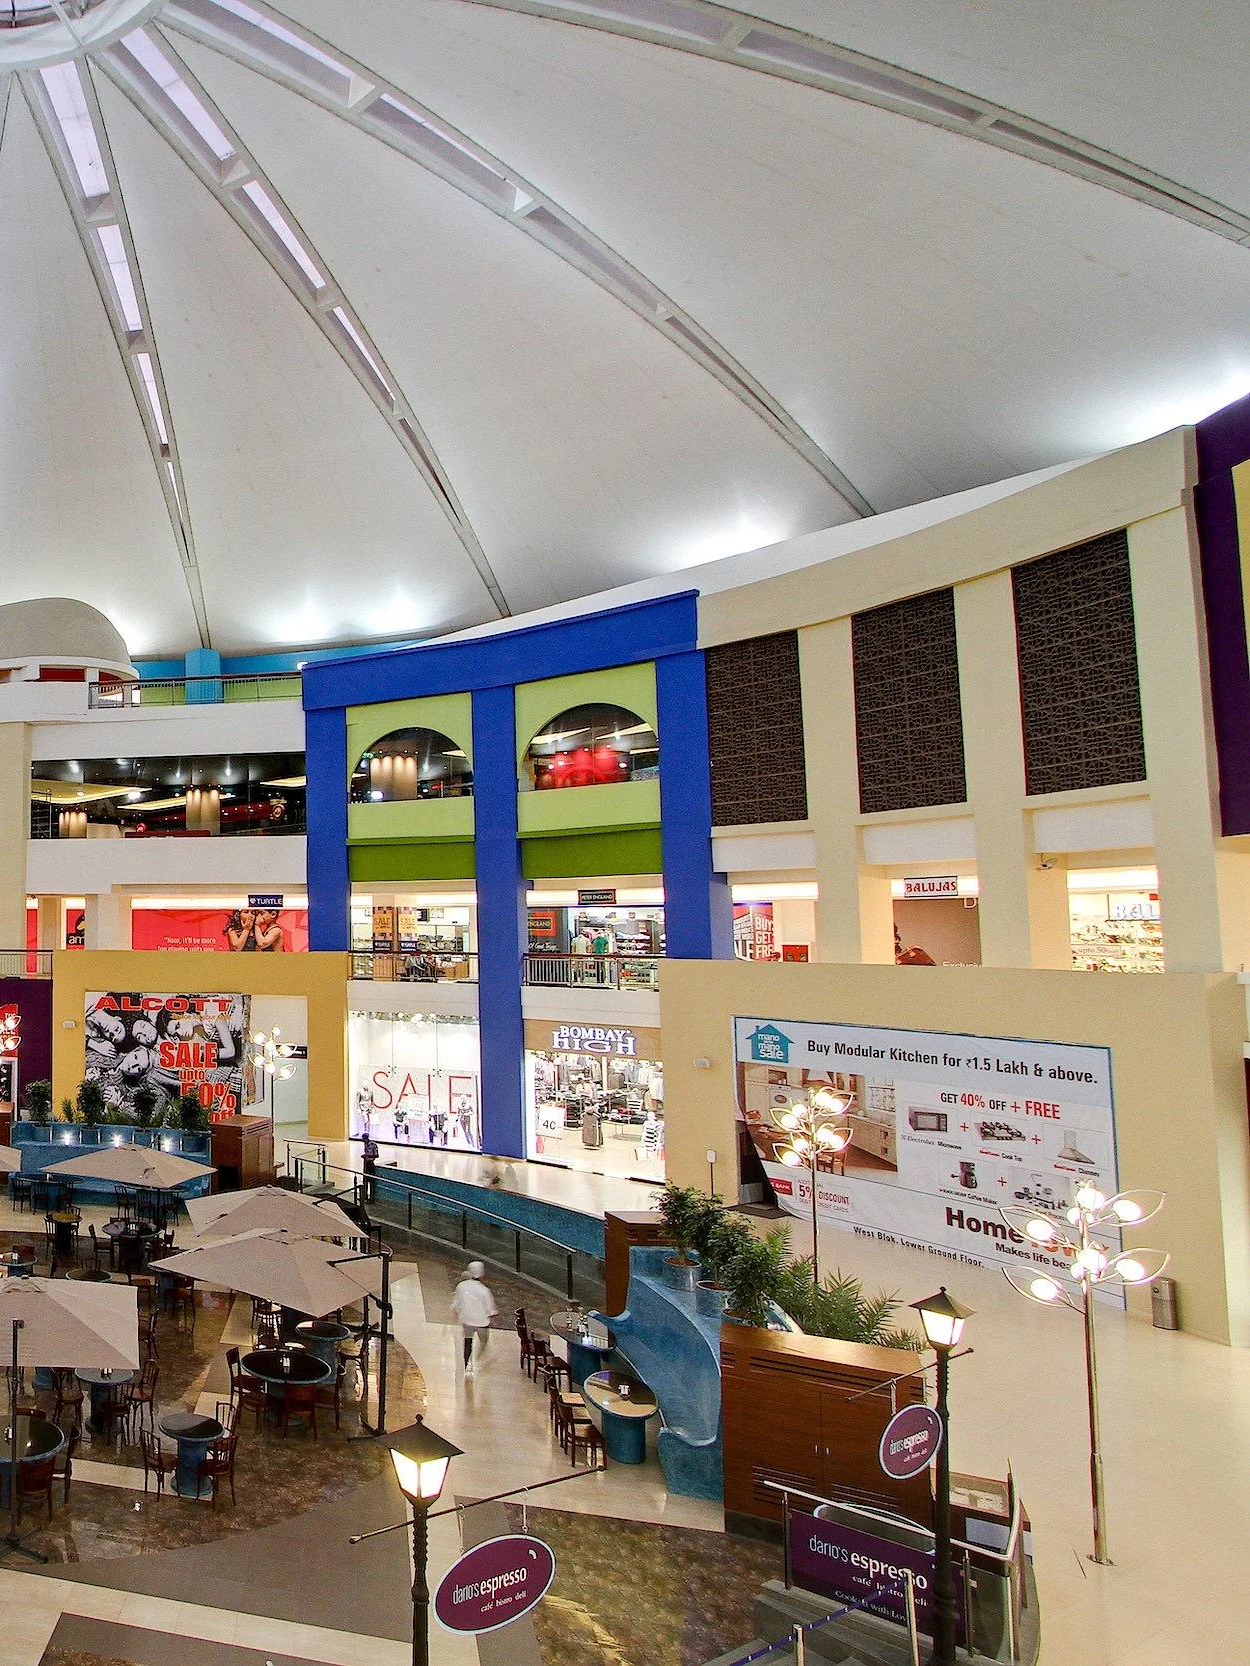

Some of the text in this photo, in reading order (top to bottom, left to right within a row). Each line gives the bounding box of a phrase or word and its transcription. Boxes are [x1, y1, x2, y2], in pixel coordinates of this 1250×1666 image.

[906, 882, 956, 892] BALUJAS
[756, 931, 772, 944] GET
[95, 996, 234, 1012] ALCOTT
[552, 1031, 636, 1056] HIGH
[560, 1026, 624, 1042] BOMBAY
[160, 1042, 218, 1069] SALE
[759, 1050, 784, 1060] sale
[808, 1040, 830, 1056] Buy
[834, 1043, 886, 1059] Modular
[890, 1048, 938, 1065] Kitchen
[943, 1054, 962, 1067] for
[996, 1059, 1028, 1075] Lakh
[1034, 1063, 1044, 1077] &
[1049, 1066, 1098, 1083] above.
[179, 1069, 206, 1082] upto
[941, 1092, 958, 1104] GET
[960, 1093, 985, 1108] 40%
[989, 1100, 1006, 1111] OFF
[1025, 1101, 1060, 1119] FREE
[819, 1191, 850, 1205] DISCOUNT
[945, 1207, 1024, 1244] Home
[853, 1226, 875, 1239] West
[900, 1238, 925, 1251] Lower
[928, 1245, 956, 1260] Ground
[960, 1253, 984, 1268] Floor.
[996, 1243, 1030, 1260] Makes
[1032, 1252, 1049, 1265] life
[809, 1535, 849, 1563] dario's
[480, 1567, 527, 1599] espresso
[852, 1576, 927, 1606] café bitro eli
[835, 1590, 868, 1608] Cookd
[892, 1610, 906, 1621] Lov
